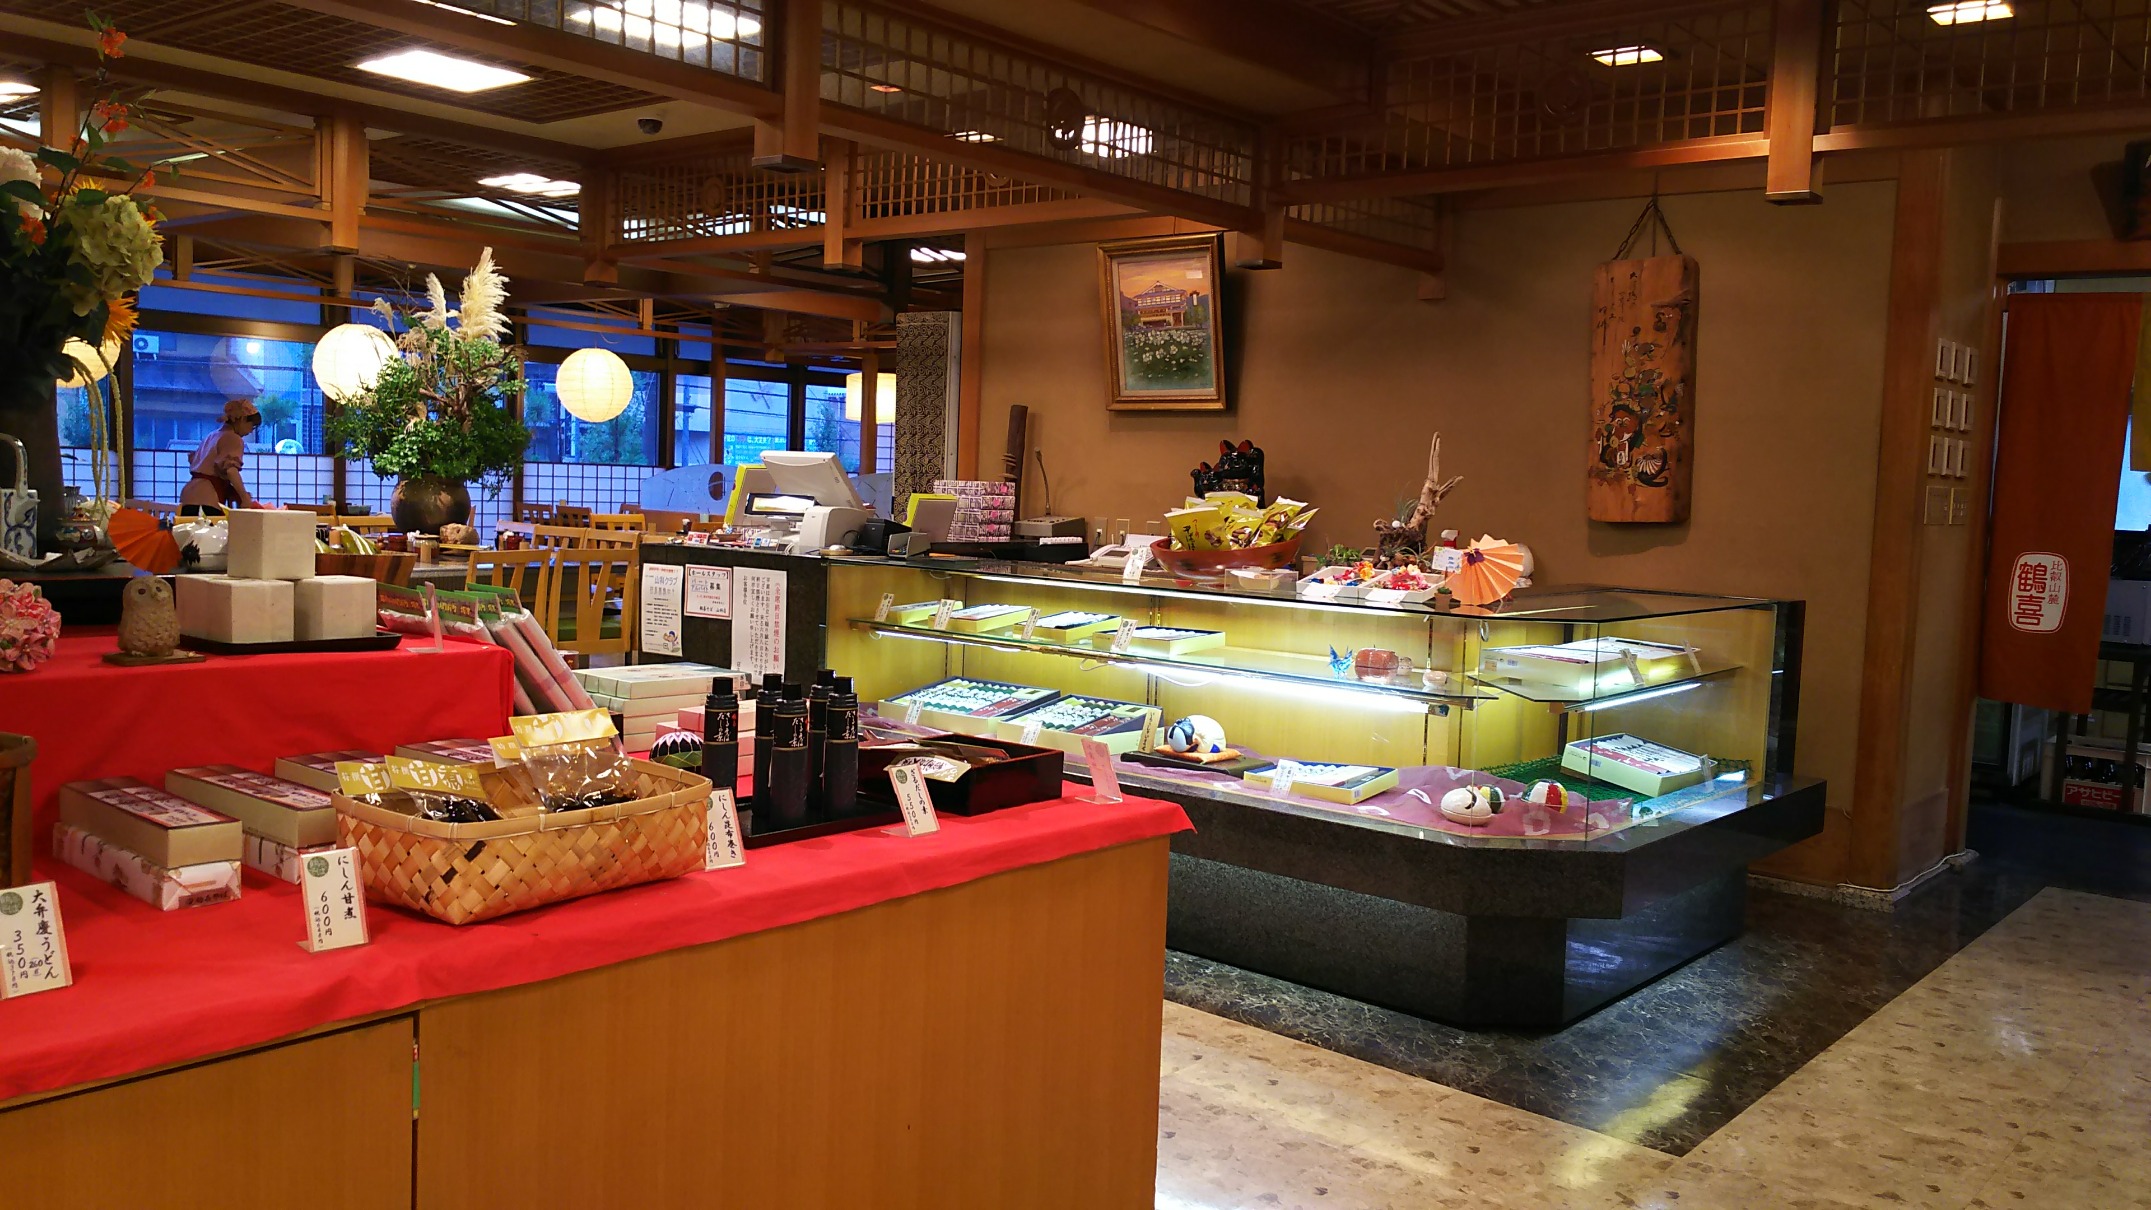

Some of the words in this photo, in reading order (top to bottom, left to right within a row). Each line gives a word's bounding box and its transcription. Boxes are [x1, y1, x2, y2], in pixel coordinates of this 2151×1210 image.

[2014, 562, 2048, 626] 鶴喜
[2047, 560, 2063, 605] 比叡山麓
[906, 793, 919, 825] 550円
[2066, 784, 2121, 801] アサヒビー
[708, 821, 720, 858] 600円
[718, 794, 738, 859] にしん昆布巻き
[337, 855, 357, 920] にしん甘煮
[31, 889, 60, 980] 大弁慶うどん
[320, 890, 333, 936] 600円
[13, 929, 29, 979] 350円
